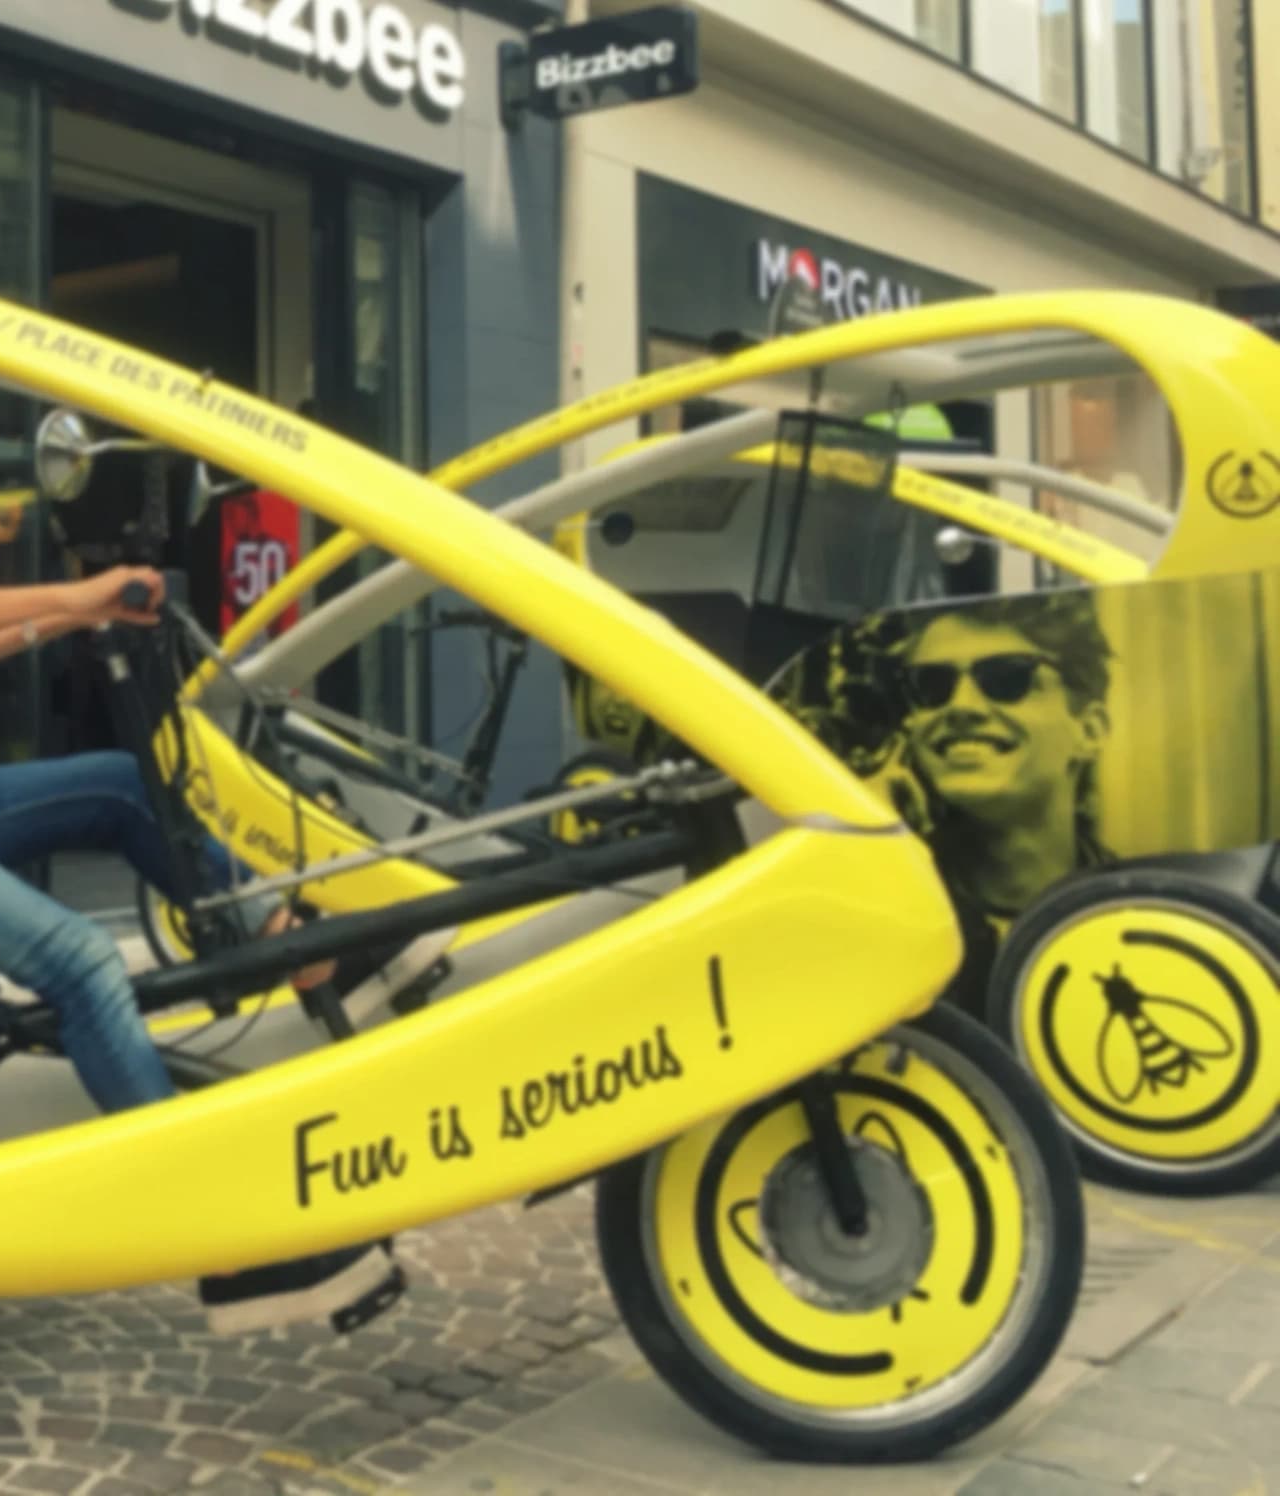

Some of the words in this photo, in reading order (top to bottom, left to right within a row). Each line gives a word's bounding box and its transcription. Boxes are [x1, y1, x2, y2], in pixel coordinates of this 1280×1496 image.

[535, 39, 675, 90] Bizzbee
[17, 322, 103, 370] PLACE
[109, 355, 166, 392] DES
[168, 376, 309, 453] PATINIERS
[234, 540, 287, 606] 50
[295, 1112, 408, 1209] Fun
[429, 1105, 473, 1161] is
[500, 1024, 683, 1140] serious
[707, 955, 734, 1050] !
